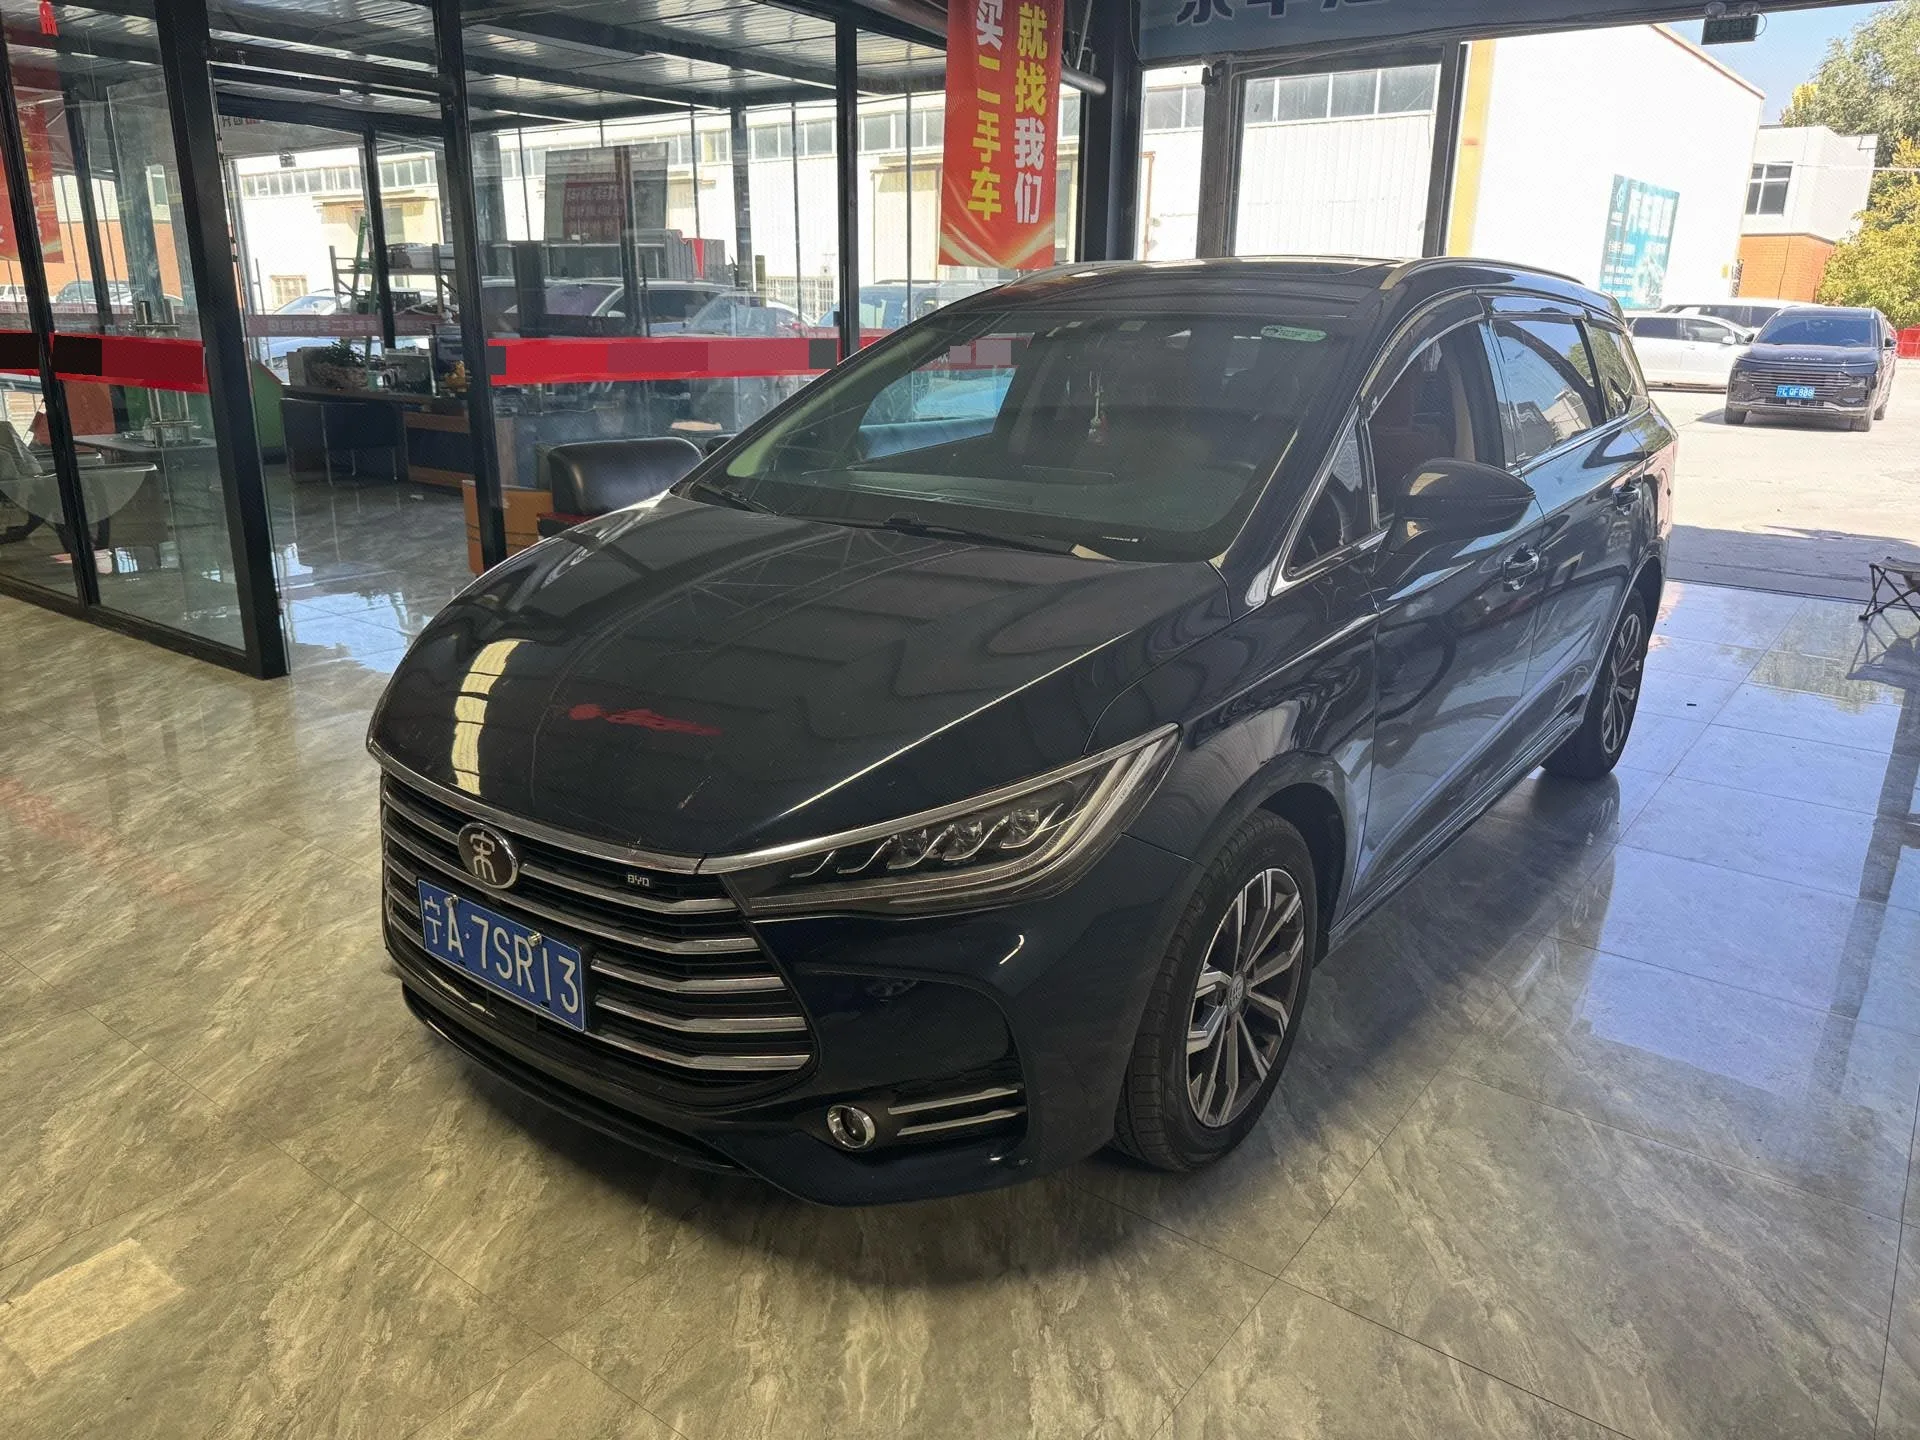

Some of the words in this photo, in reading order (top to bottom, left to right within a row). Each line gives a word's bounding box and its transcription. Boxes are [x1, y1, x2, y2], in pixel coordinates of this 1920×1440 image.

[967, 0, 1004, 221] 买二手车
[1014, 1, 1048, 224] 就找我们
[627, 874, 650, 887] BYD
